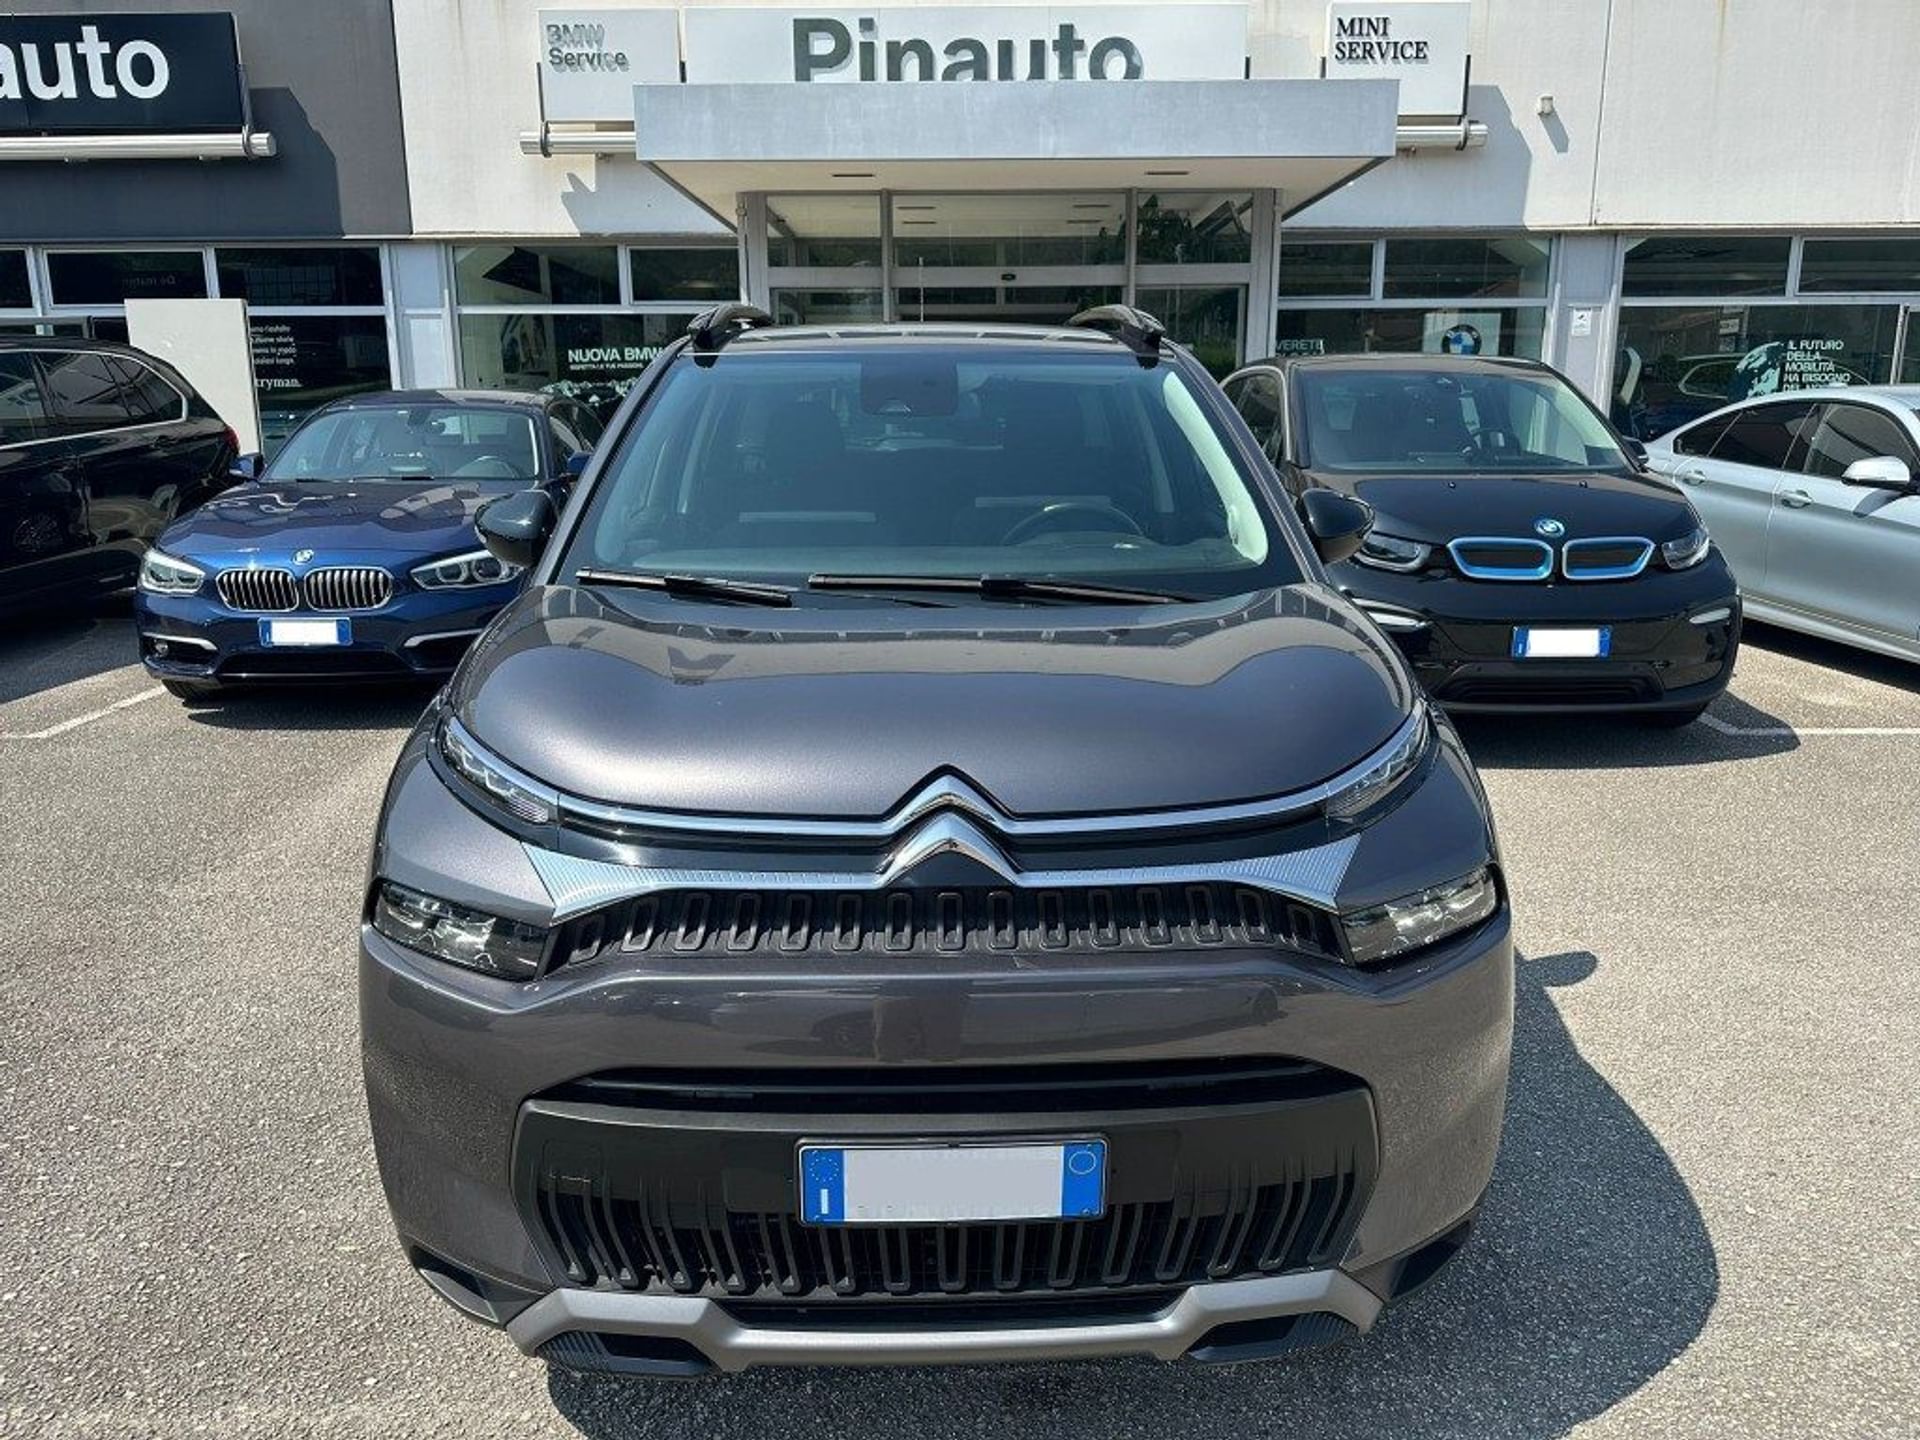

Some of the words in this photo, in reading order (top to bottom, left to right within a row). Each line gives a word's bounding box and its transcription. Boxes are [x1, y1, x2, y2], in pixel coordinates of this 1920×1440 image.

[547, 24, 605, 48] BMW
[1336, 16, 1390, 37] MINI
[549, 47, 629, 70] Service
[793, 18, 1143, 81] Pinauto
[1335, 41, 1428, 61] SERVICE
[568, 347, 621, 362] NUOVA
[1800, 340, 1845, 350] FUTURO
[1787, 351, 1820, 361] DELLA
[1802, 373, 1850, 382] BISOGNO
